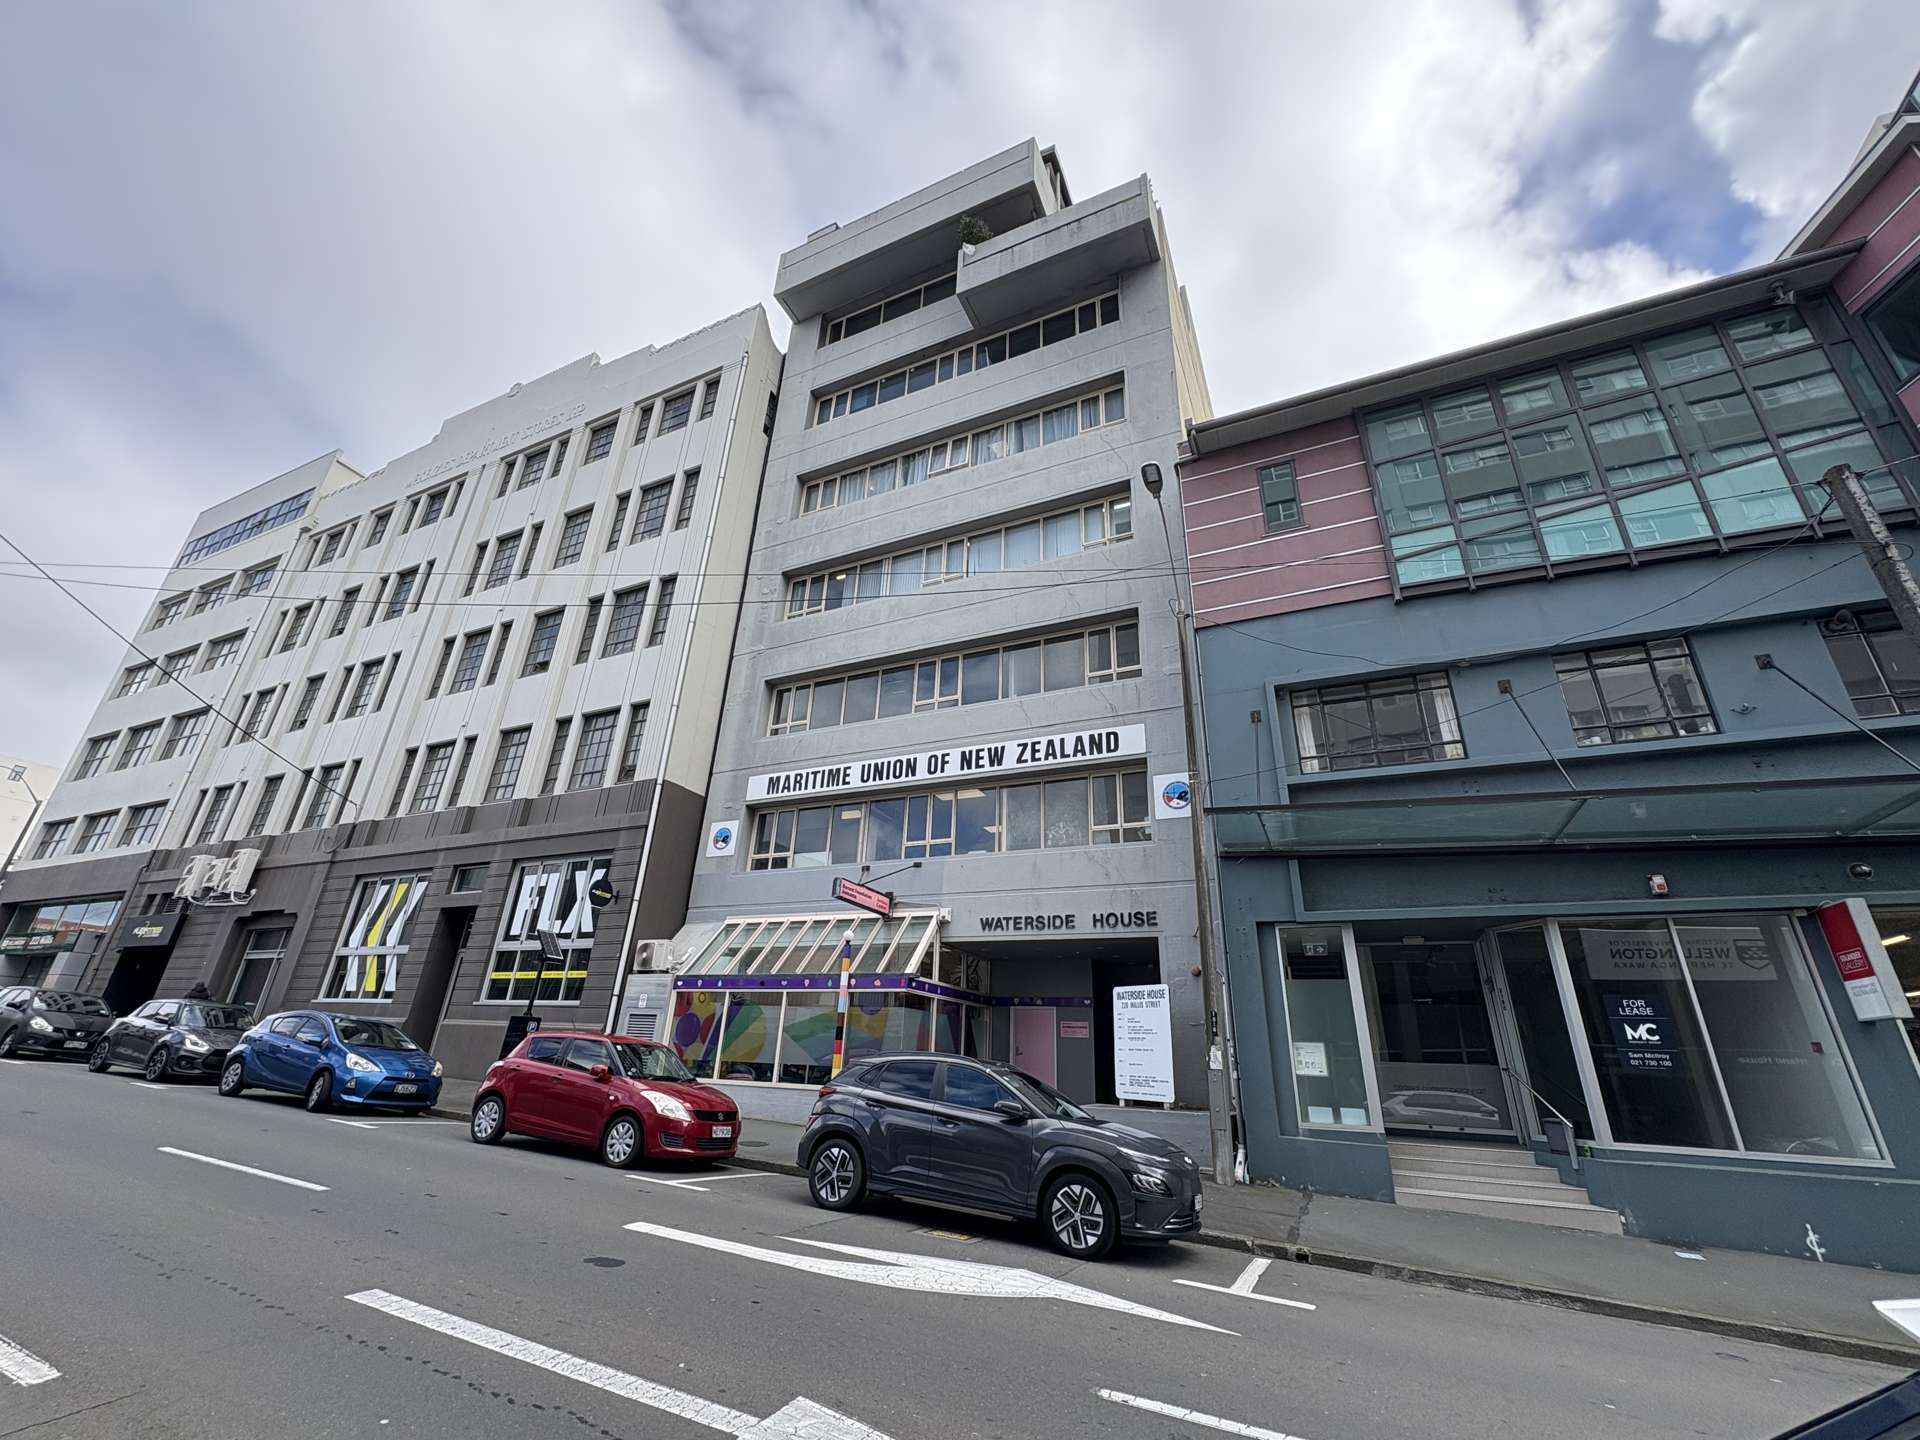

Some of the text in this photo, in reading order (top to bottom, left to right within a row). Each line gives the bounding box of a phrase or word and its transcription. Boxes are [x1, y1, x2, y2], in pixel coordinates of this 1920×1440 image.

[766, 730, 1120, 796] MARITIME UNION OF NEW ZEALAND
[509, 868, 608, 936] FLX
[980, 911, 1158, 932] WATERSIDE HOUSE
[1116, 989, 1166, 1001] WATERSIDE HOUSE
[1130, 1001, 1144, 1009] WILLIS
[1145, 1000, 1161, 1008] STREET
[1622, 999, 1646, 1008] FOR
[1618, 1007, 1654, 1016] LEASE
[1623, 1023, 1661, 1041] MC
